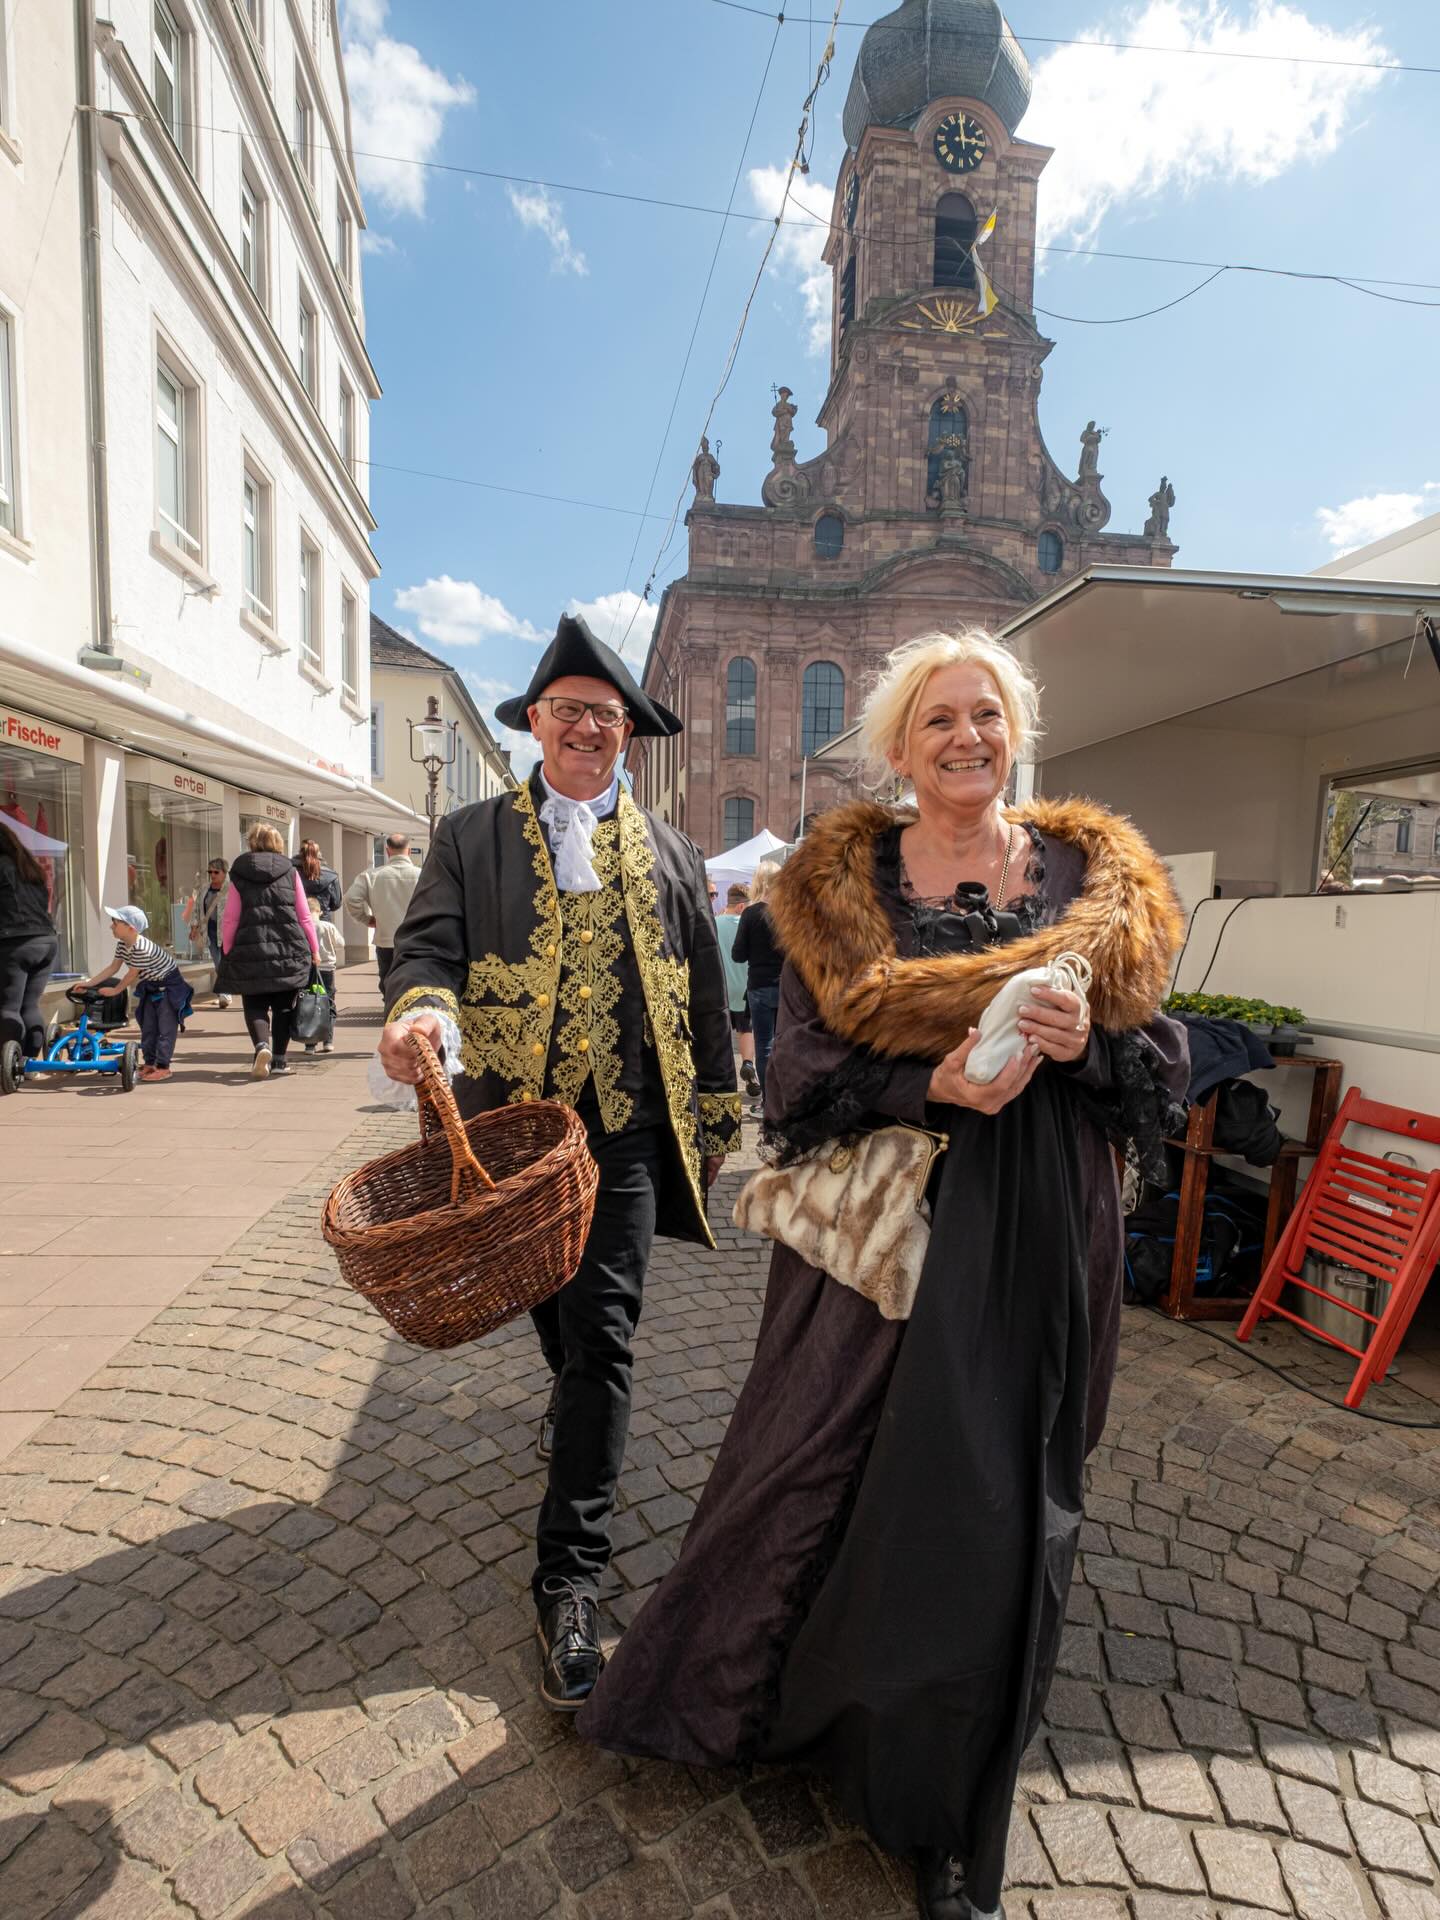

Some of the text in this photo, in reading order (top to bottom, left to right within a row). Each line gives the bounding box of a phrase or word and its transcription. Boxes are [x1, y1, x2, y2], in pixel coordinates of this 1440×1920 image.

[0, 717, 61, 750] rFischer
[174, 775, 207, 795] ertel
[266, 805, 287, 819] ertel
